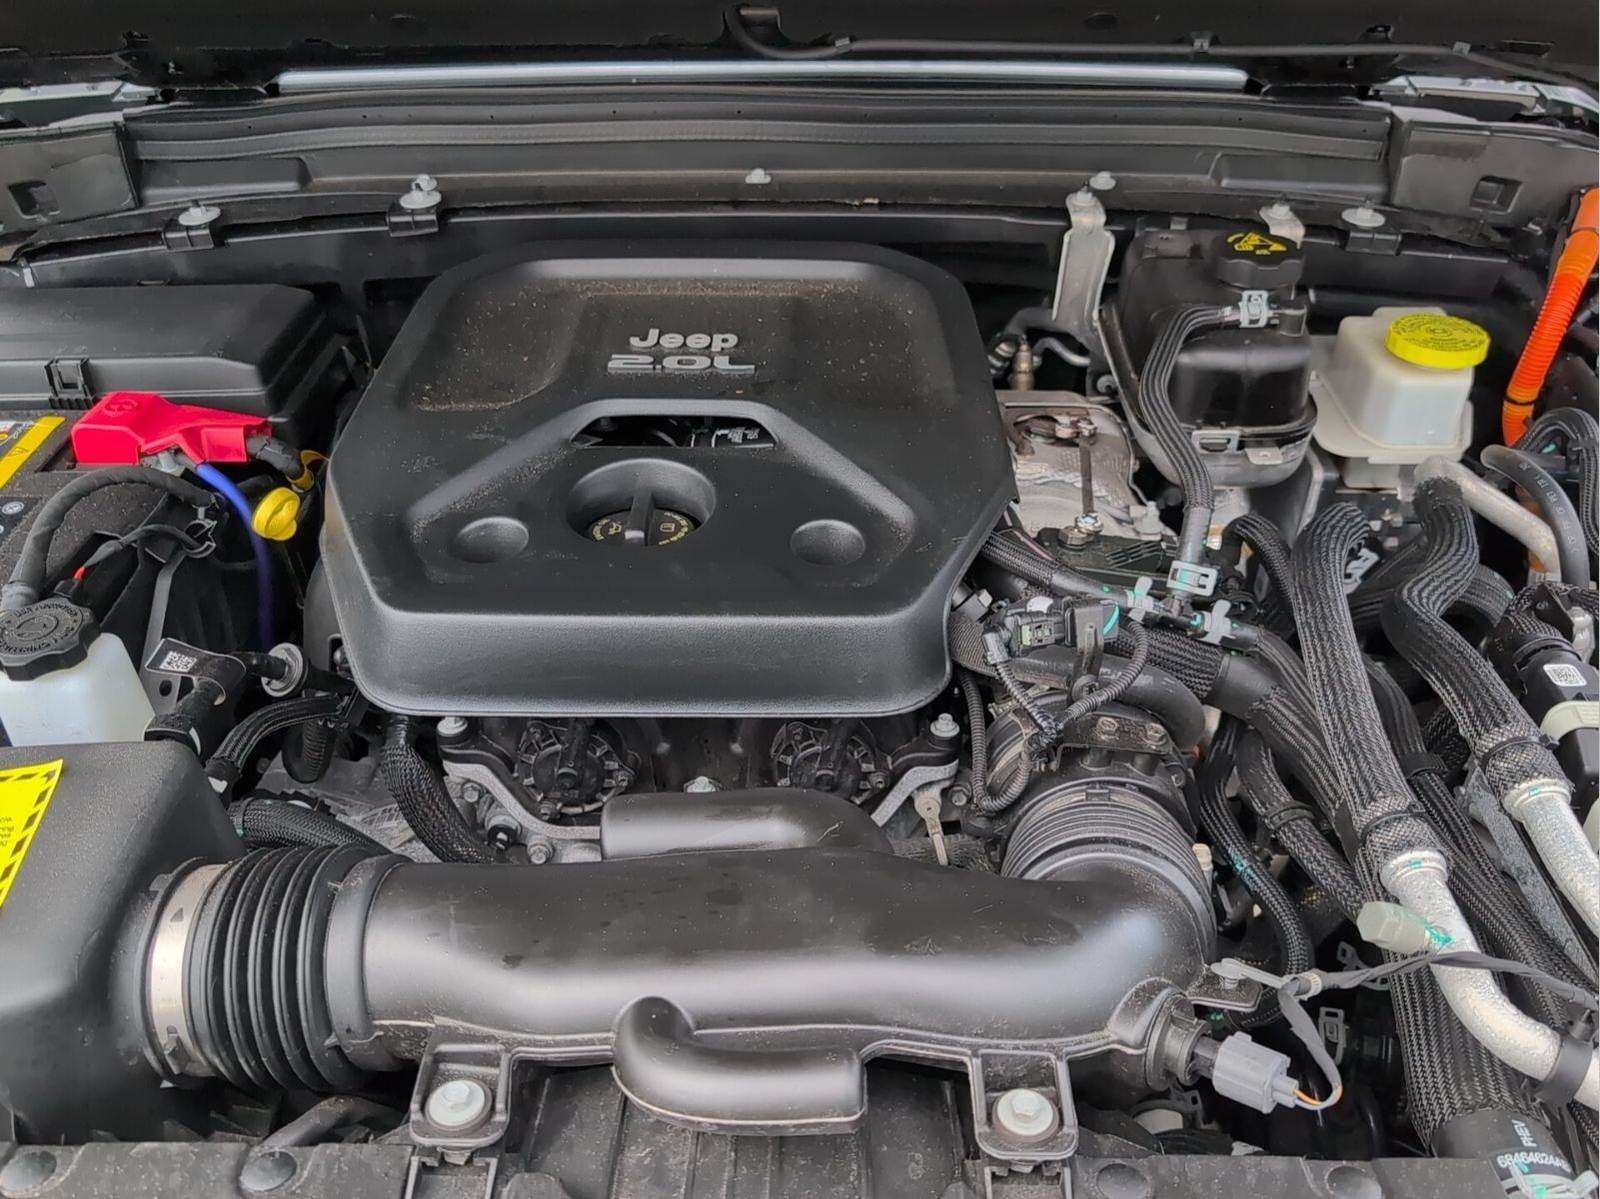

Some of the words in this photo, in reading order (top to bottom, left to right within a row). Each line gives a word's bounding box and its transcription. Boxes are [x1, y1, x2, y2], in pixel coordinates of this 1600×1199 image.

[629, 328, 738, 352] Jeep
[607, 354, 755, 374] 2.0L
[1511, 1119, 1537, 1147] PHEV
